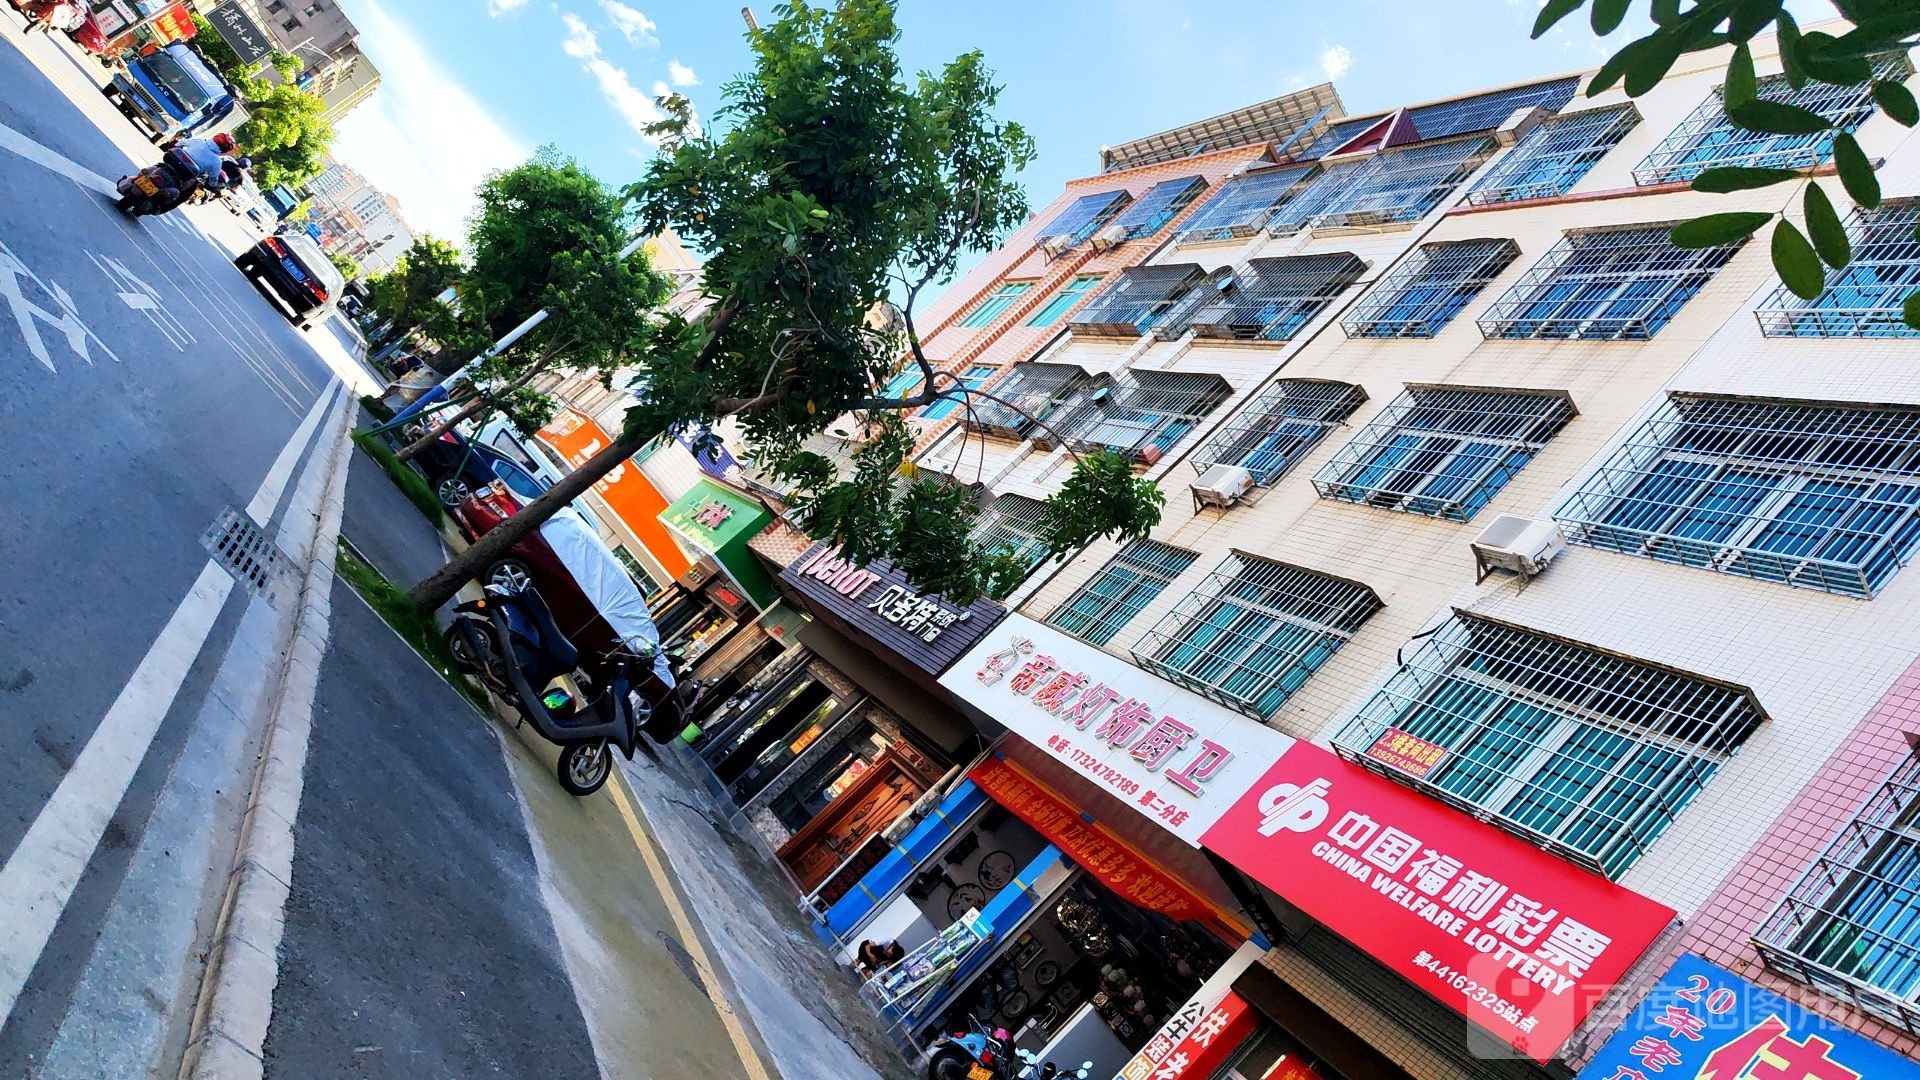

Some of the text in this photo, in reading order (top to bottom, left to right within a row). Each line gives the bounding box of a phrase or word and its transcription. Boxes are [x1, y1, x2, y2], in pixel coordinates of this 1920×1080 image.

[153, 81, 170, 97] JAC
[867, 584, 940, 632] 贝洛特
[1009, 653, 1236, 798] 帝威灯饰厨卫
[1369, 746, 1428, 777] 13926743686
[1137, 789, 1190, 828] 第二分店
[1311, 840, 1577, 997] CHINA WELFARE LOTTERY
[1326, 809, 1613, 979] 中国福利彩票
[1411, 950, 1540, 1035] 第44162325站点
